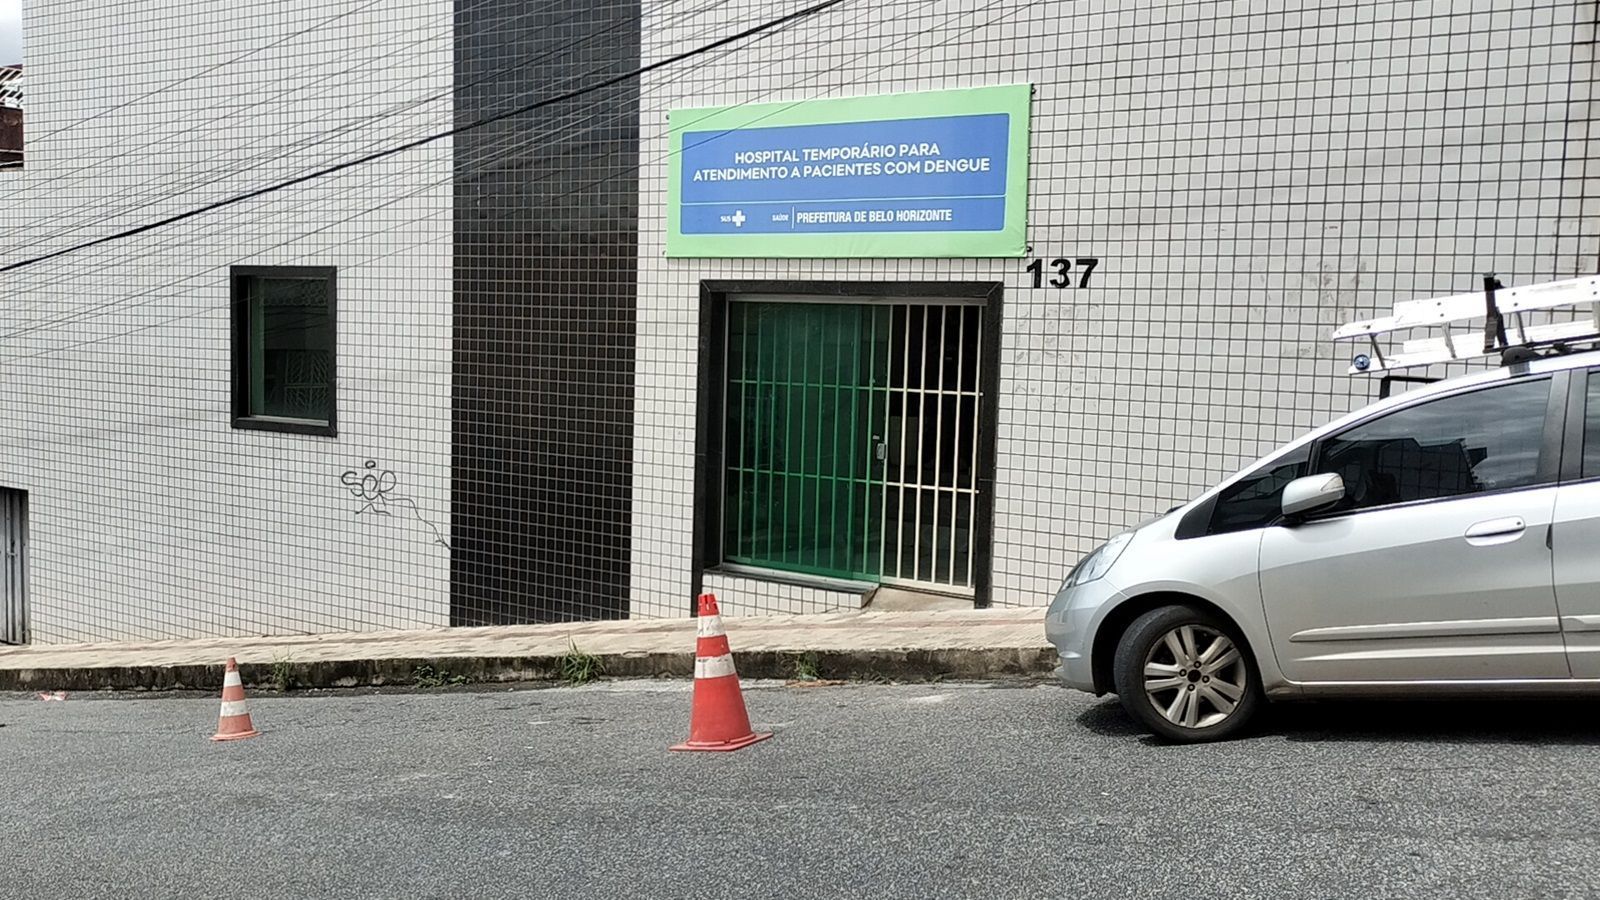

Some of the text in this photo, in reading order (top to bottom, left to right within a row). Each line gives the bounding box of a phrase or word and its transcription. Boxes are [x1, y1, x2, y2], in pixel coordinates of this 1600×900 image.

[734, 142, 940, 164] HOSPITAL TEMPORÁRIO PARA
[693, 158, 990, 182] ATENDIMENTO A PACIENTES COM DENGUE
[796, 209, 952, 223] PREFEITURA DE BELO HORIZONTE
[1026, 258, 1099, 289] 137
